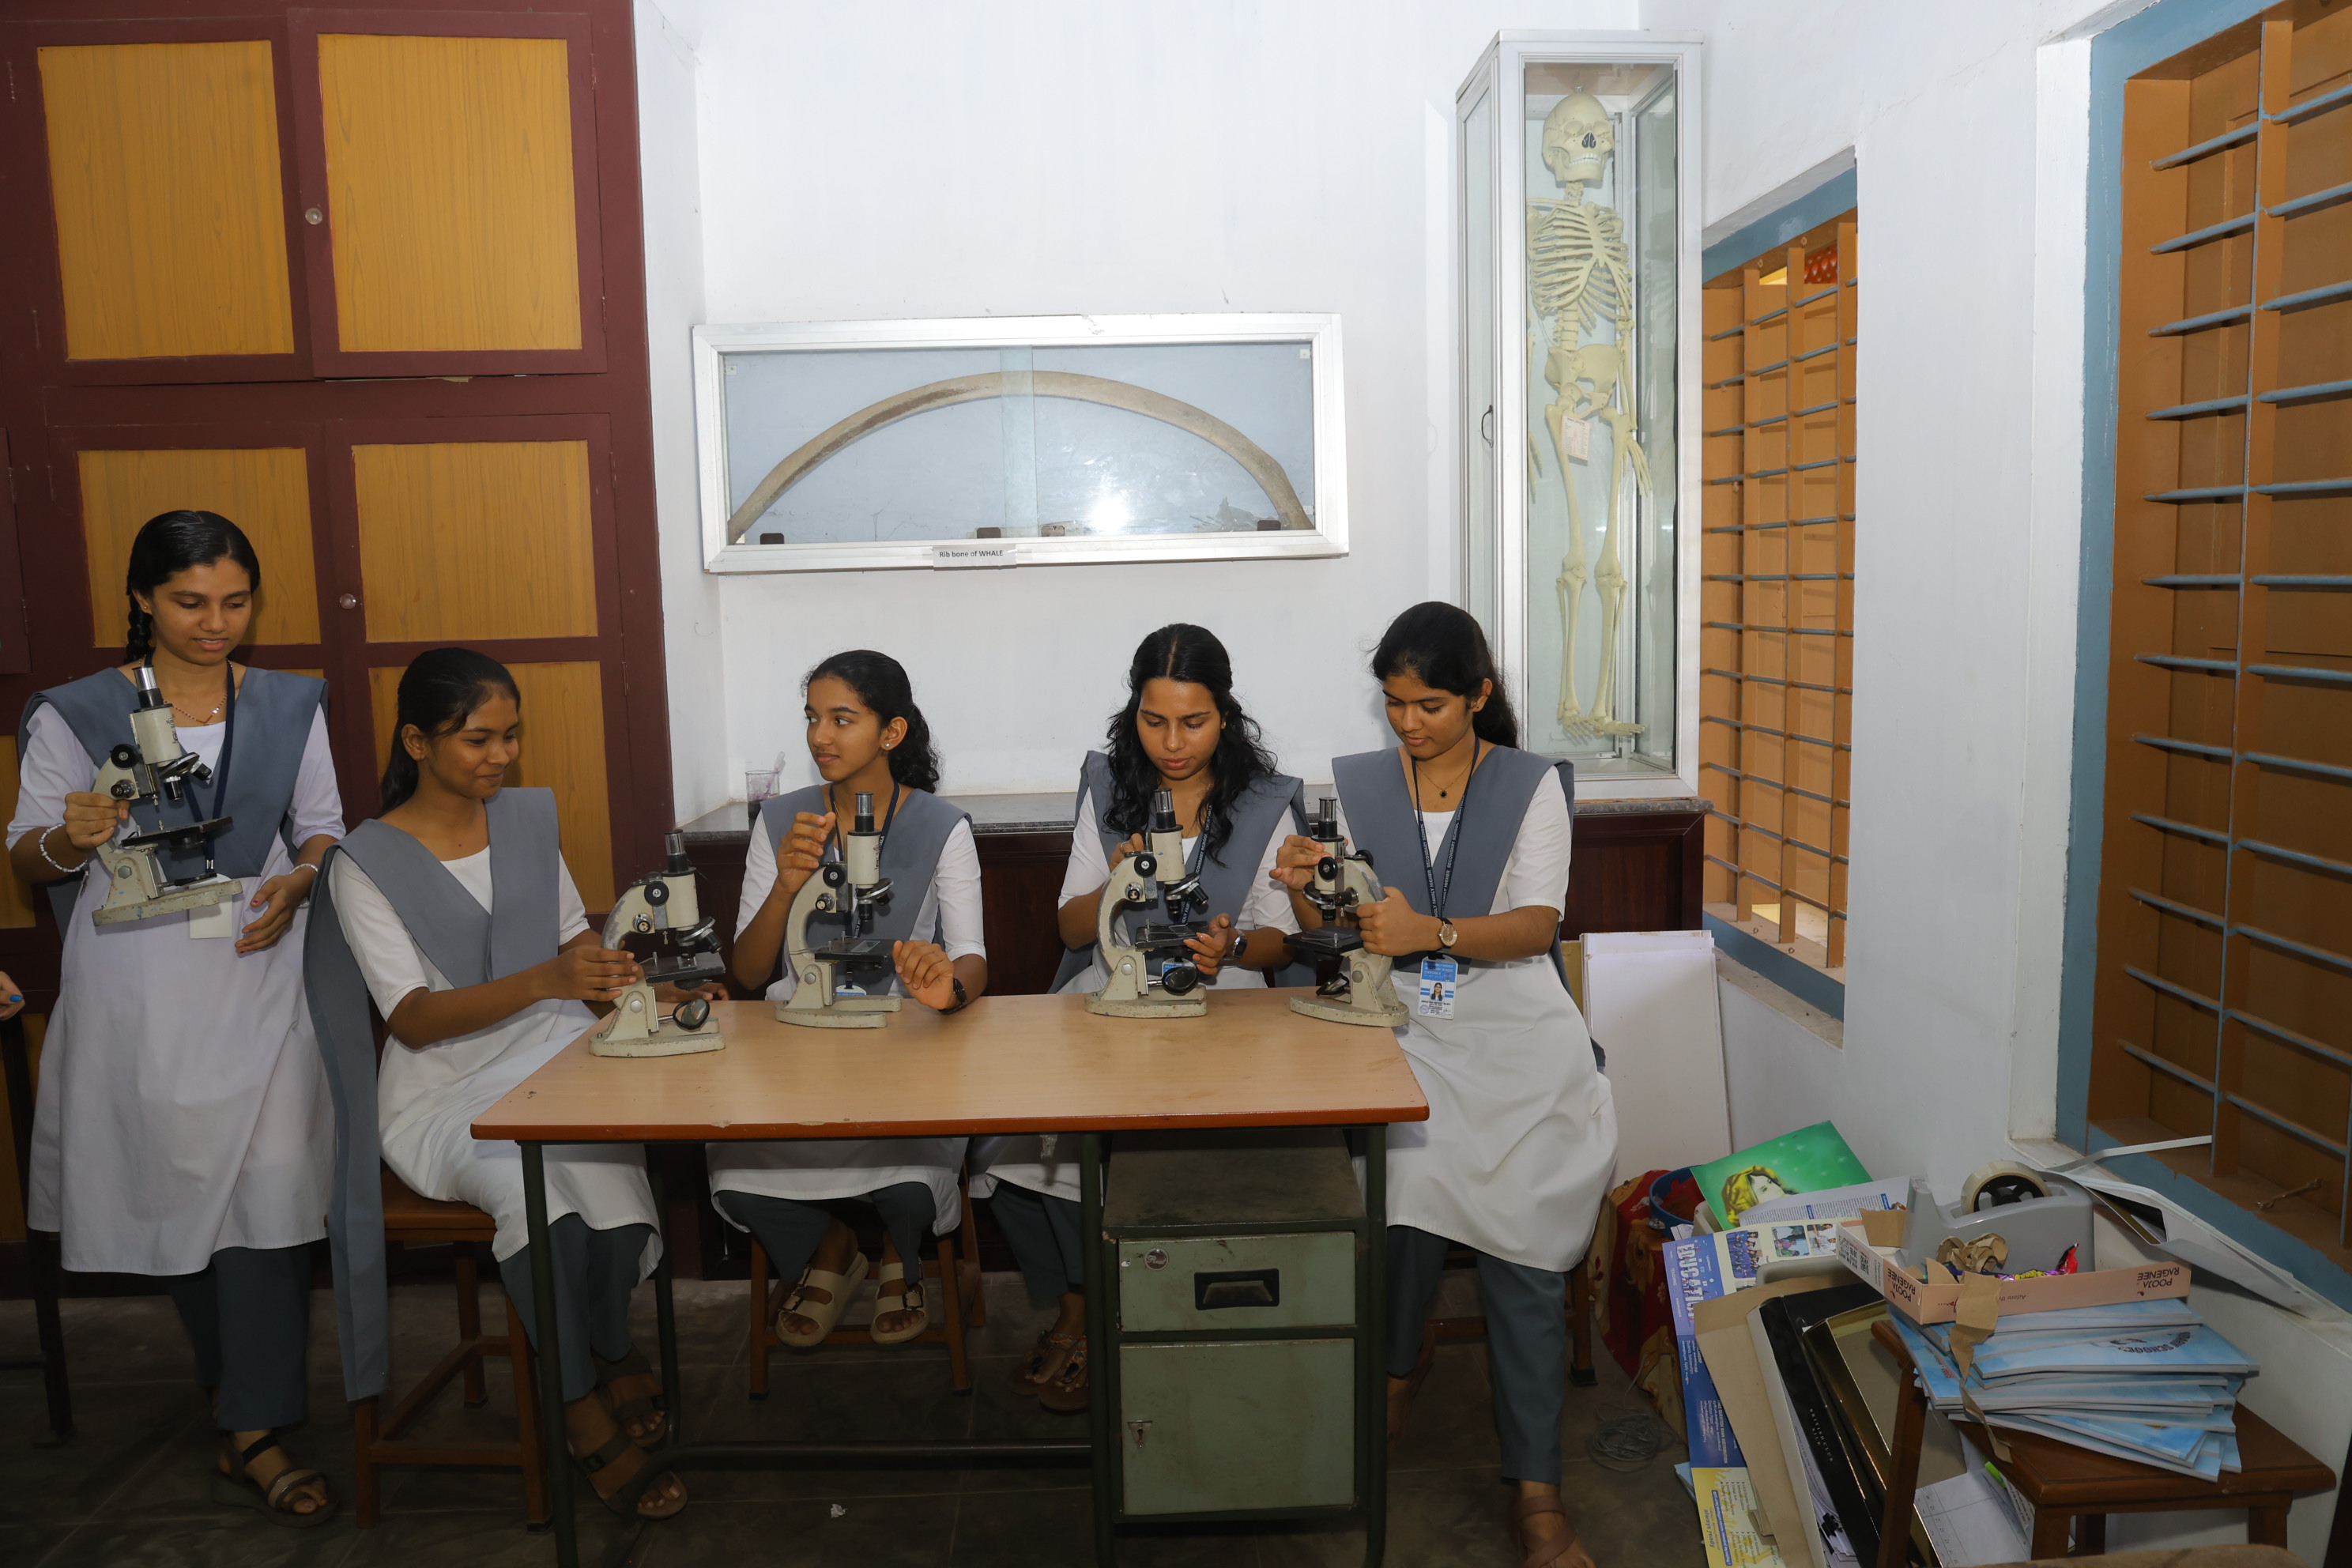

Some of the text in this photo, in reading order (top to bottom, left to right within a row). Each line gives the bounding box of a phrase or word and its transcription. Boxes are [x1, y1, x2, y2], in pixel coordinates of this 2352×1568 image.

[1888, 1268, 1915, 1295] RAGENEE
[2137, 1267, 2180, 1281] RAGENEE
[2143, 1277, 2173, 1288] POOJA
[1892, 1281, 1911, 1302] POOJA
[1810, 1408, 1833, 1461] BRITISH CLUB
[1812, 1428, 1821, 1446] SILK
